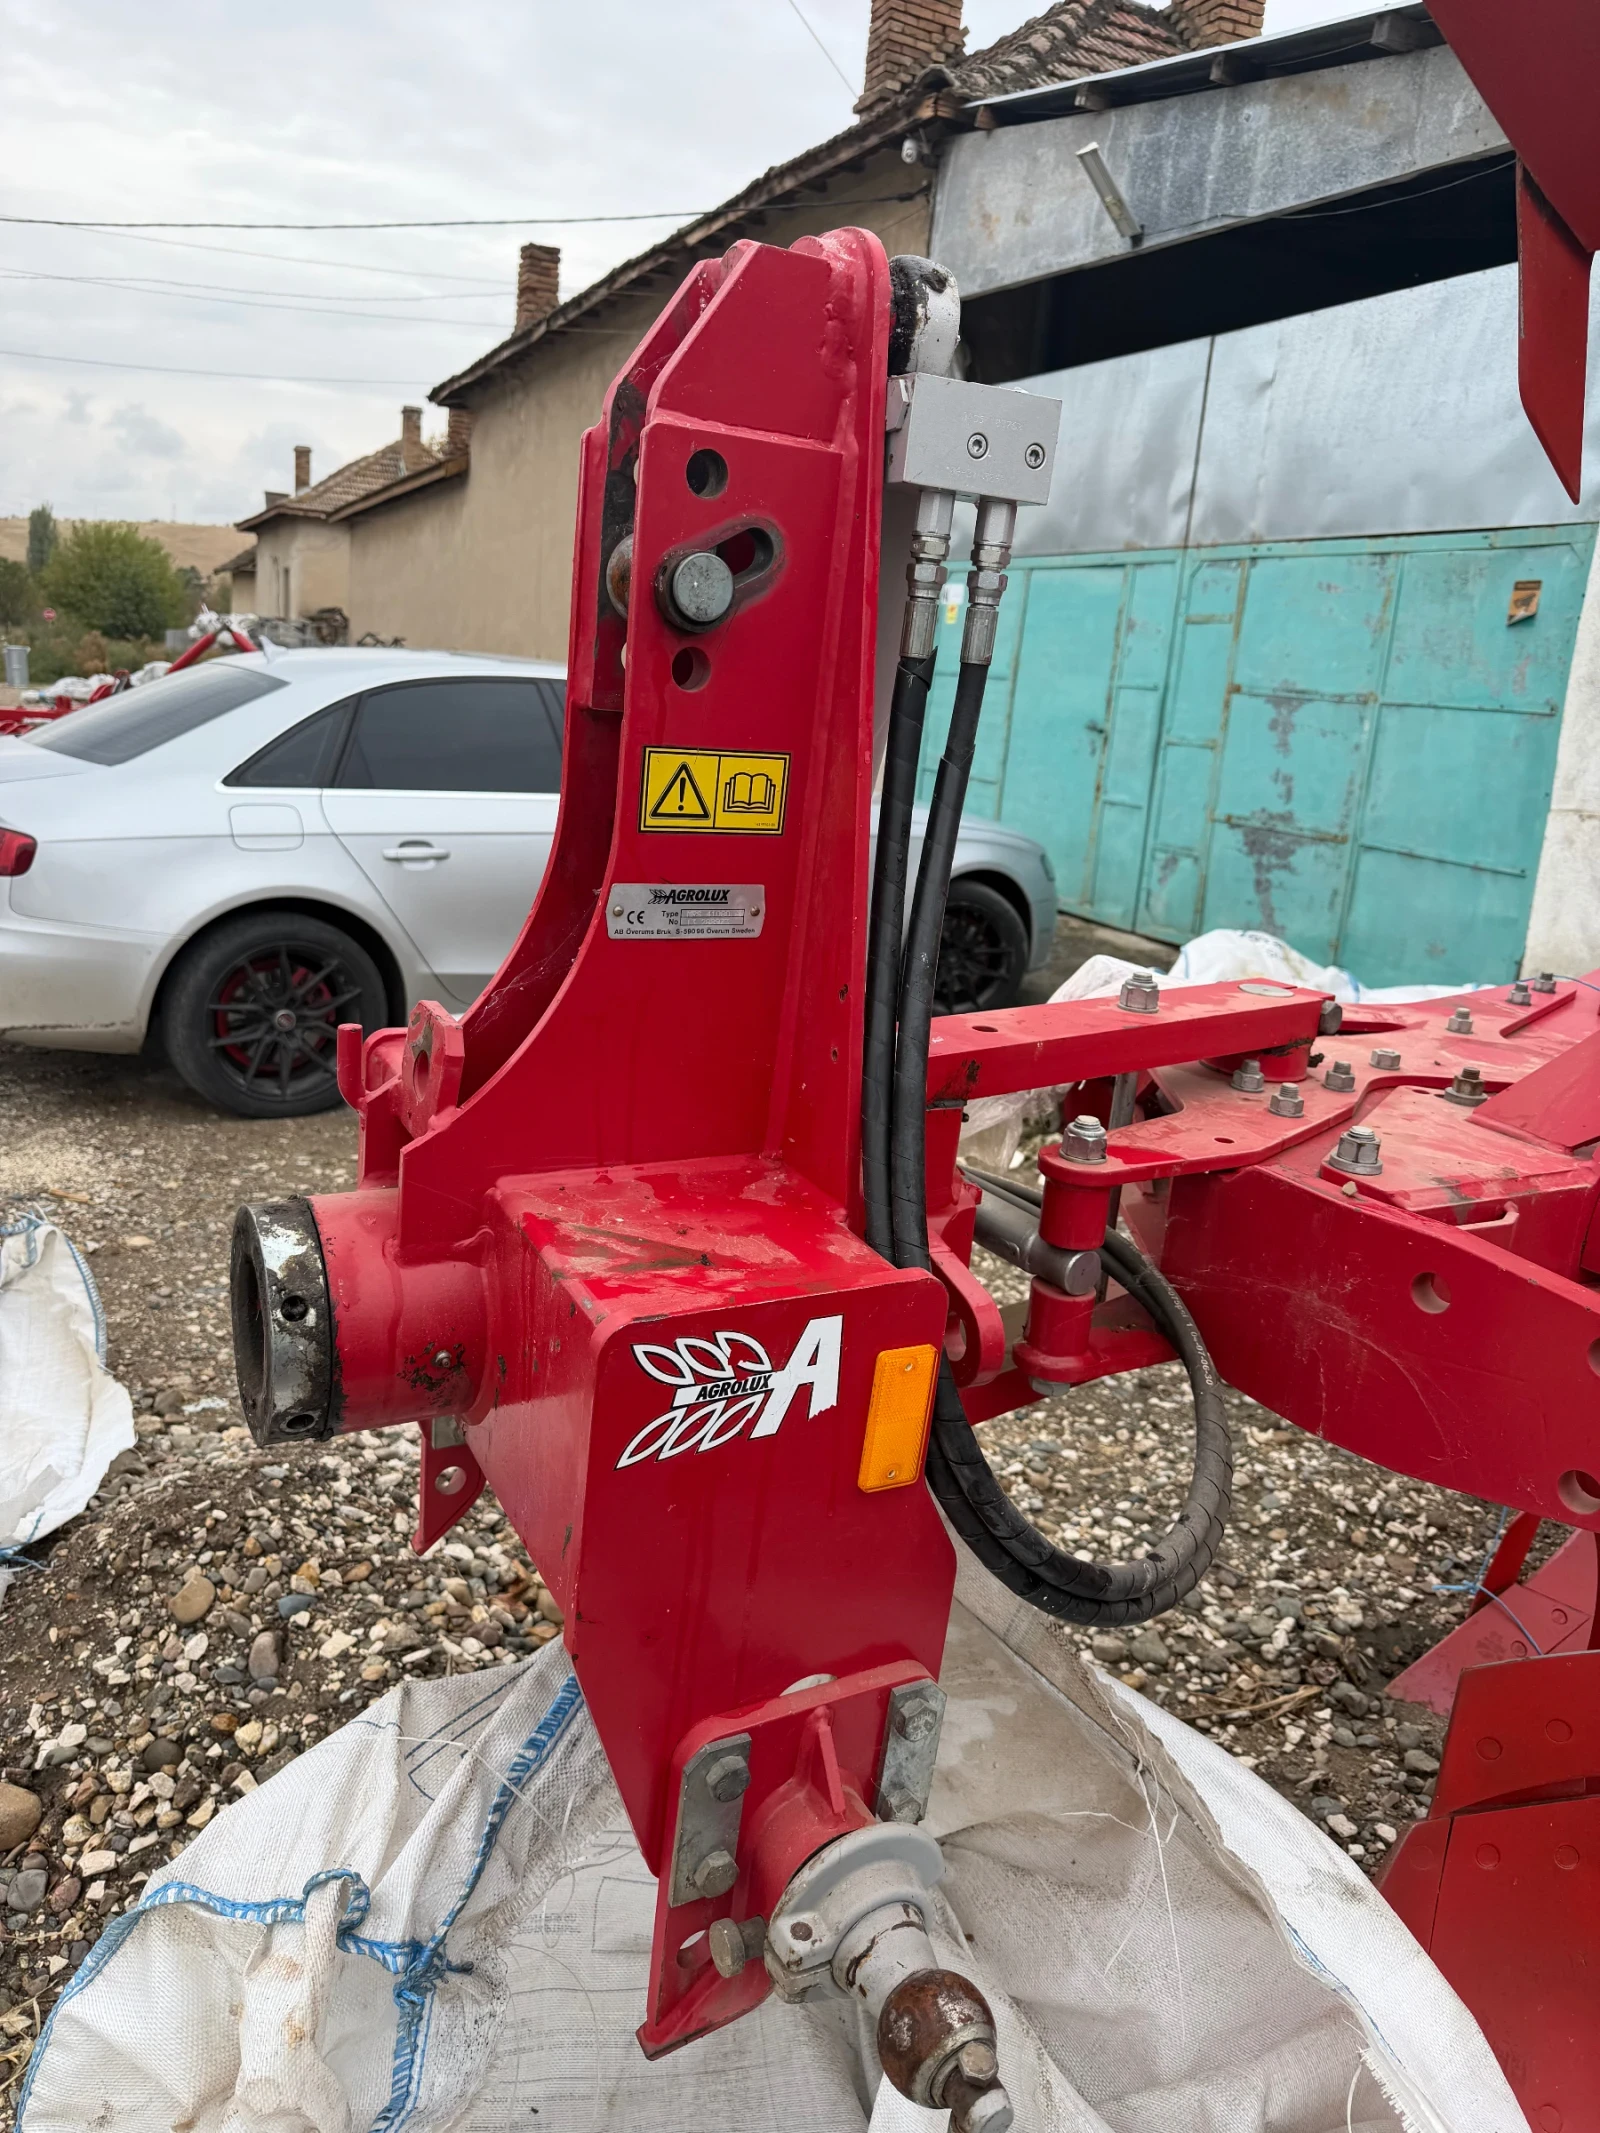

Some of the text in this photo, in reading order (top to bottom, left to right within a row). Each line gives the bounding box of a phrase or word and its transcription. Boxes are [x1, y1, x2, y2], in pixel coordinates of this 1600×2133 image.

[665, 889, 730, 904] AGROLUX
[627, 911, 645, 924] CE
[661, 910, 679, 918] Type
[695, 1373, 772, 1401] AGROLUX
